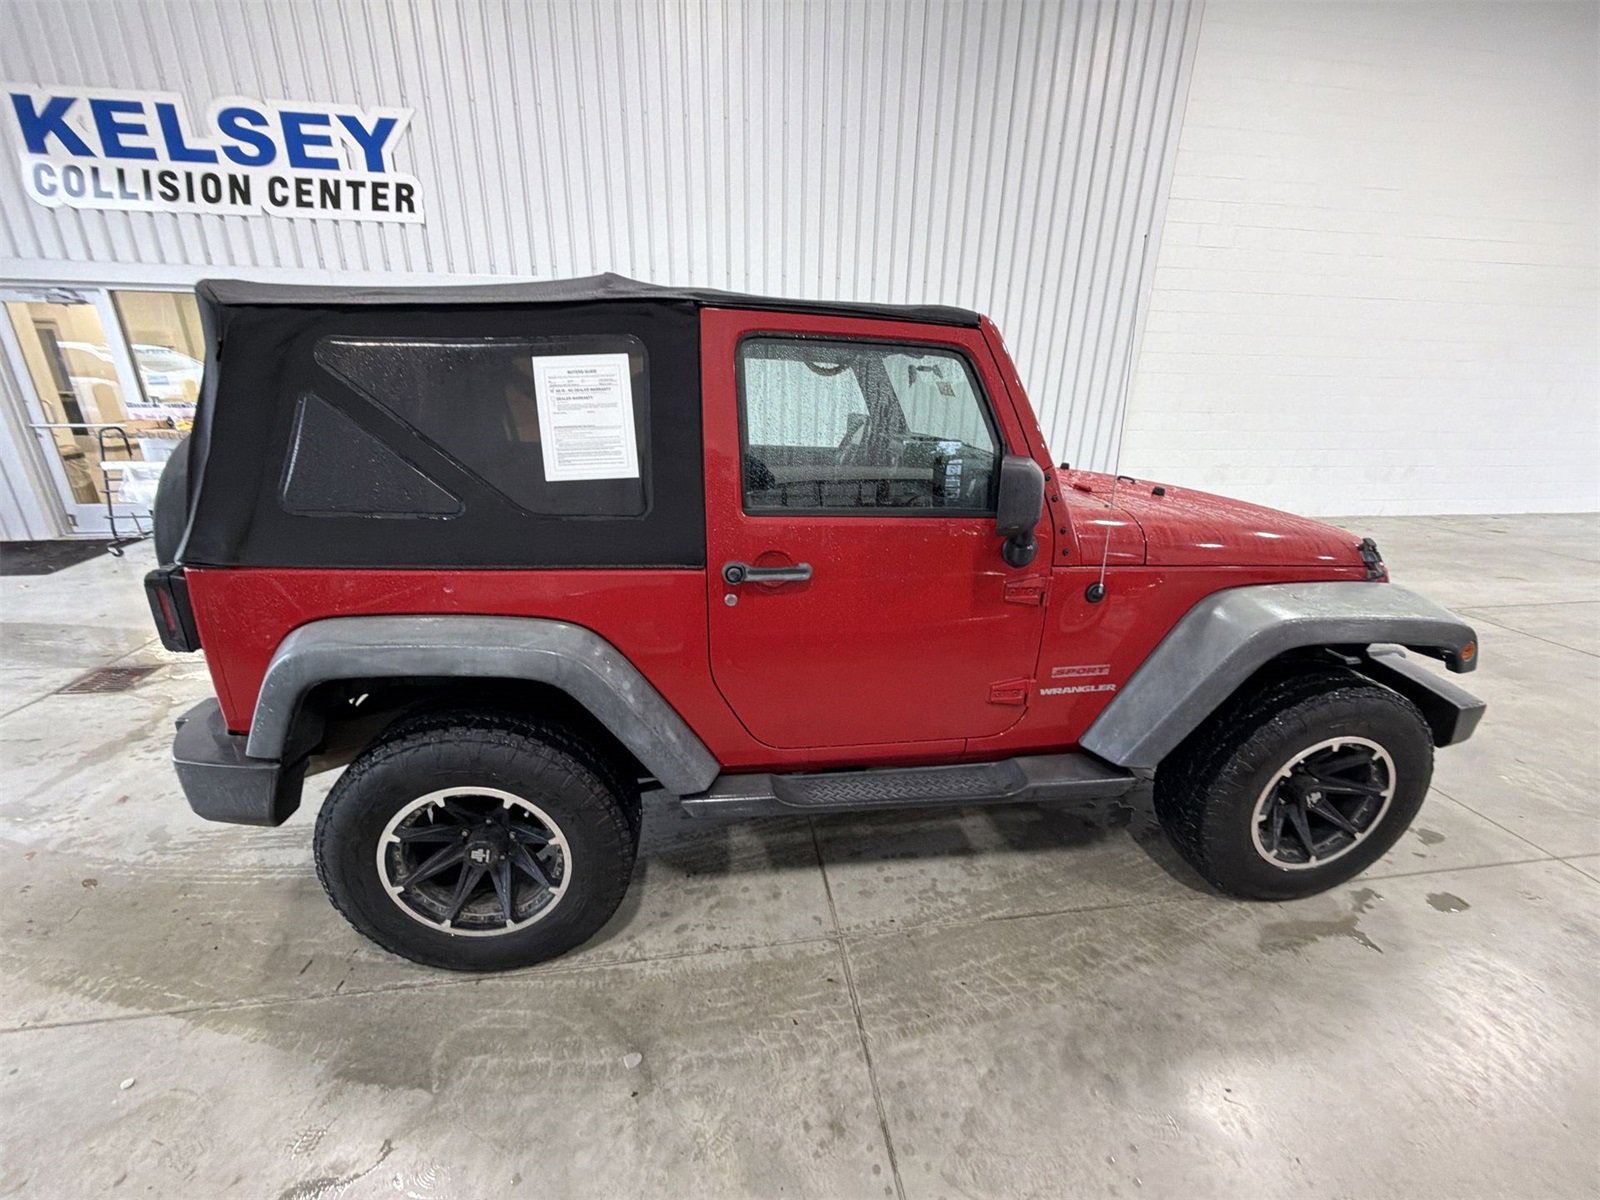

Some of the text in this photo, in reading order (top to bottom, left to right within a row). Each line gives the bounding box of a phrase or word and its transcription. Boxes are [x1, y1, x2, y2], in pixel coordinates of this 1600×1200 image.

[9, 93, 398, 173] KELSEY
[33, 162, 417, 214] COLLISION CENTER
[1053, 666, 1108, 676] SPORT
[1040, 684, 1117, 695] WRANGLER
